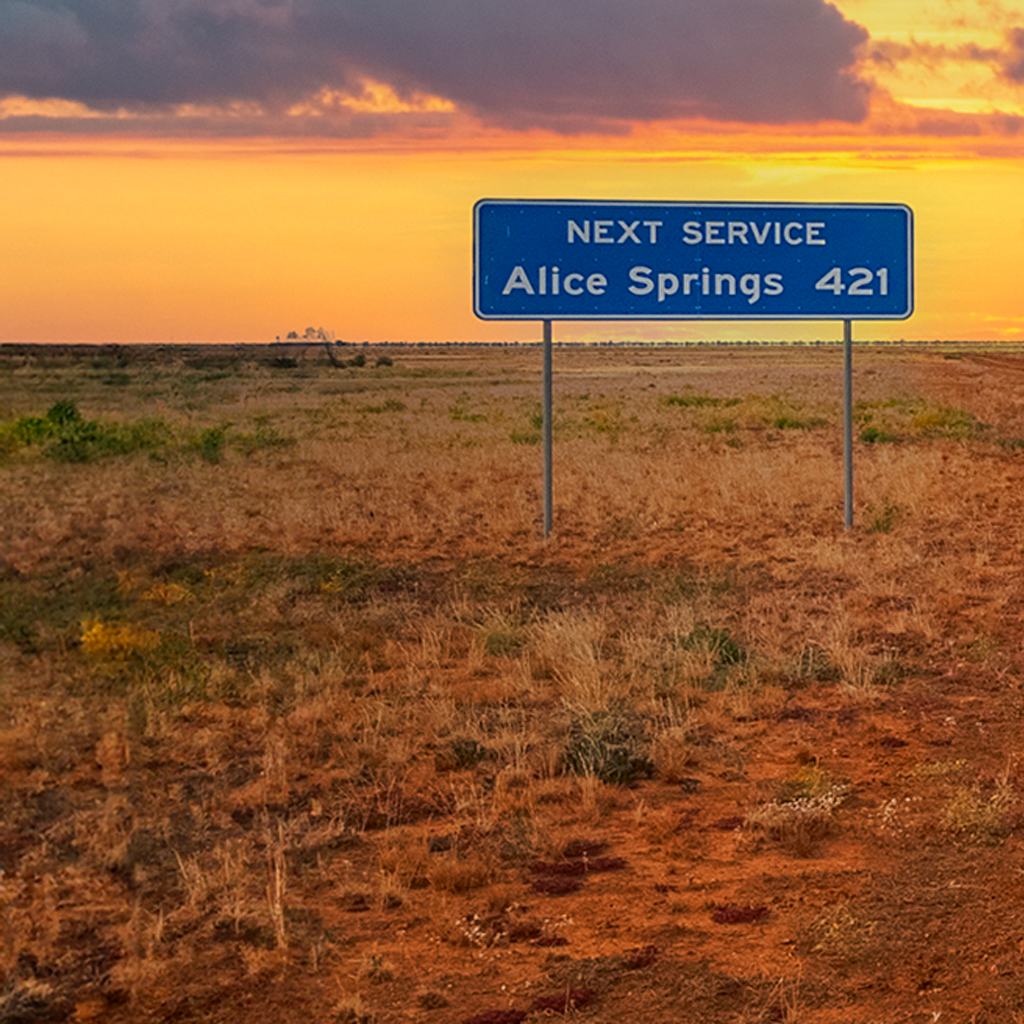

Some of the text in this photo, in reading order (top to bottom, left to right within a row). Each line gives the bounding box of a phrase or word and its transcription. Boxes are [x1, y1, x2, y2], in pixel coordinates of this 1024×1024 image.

[567, 220, 826, 245] NEXT SERVICE
[502, 266, 888, 304] Alice Springs 421
